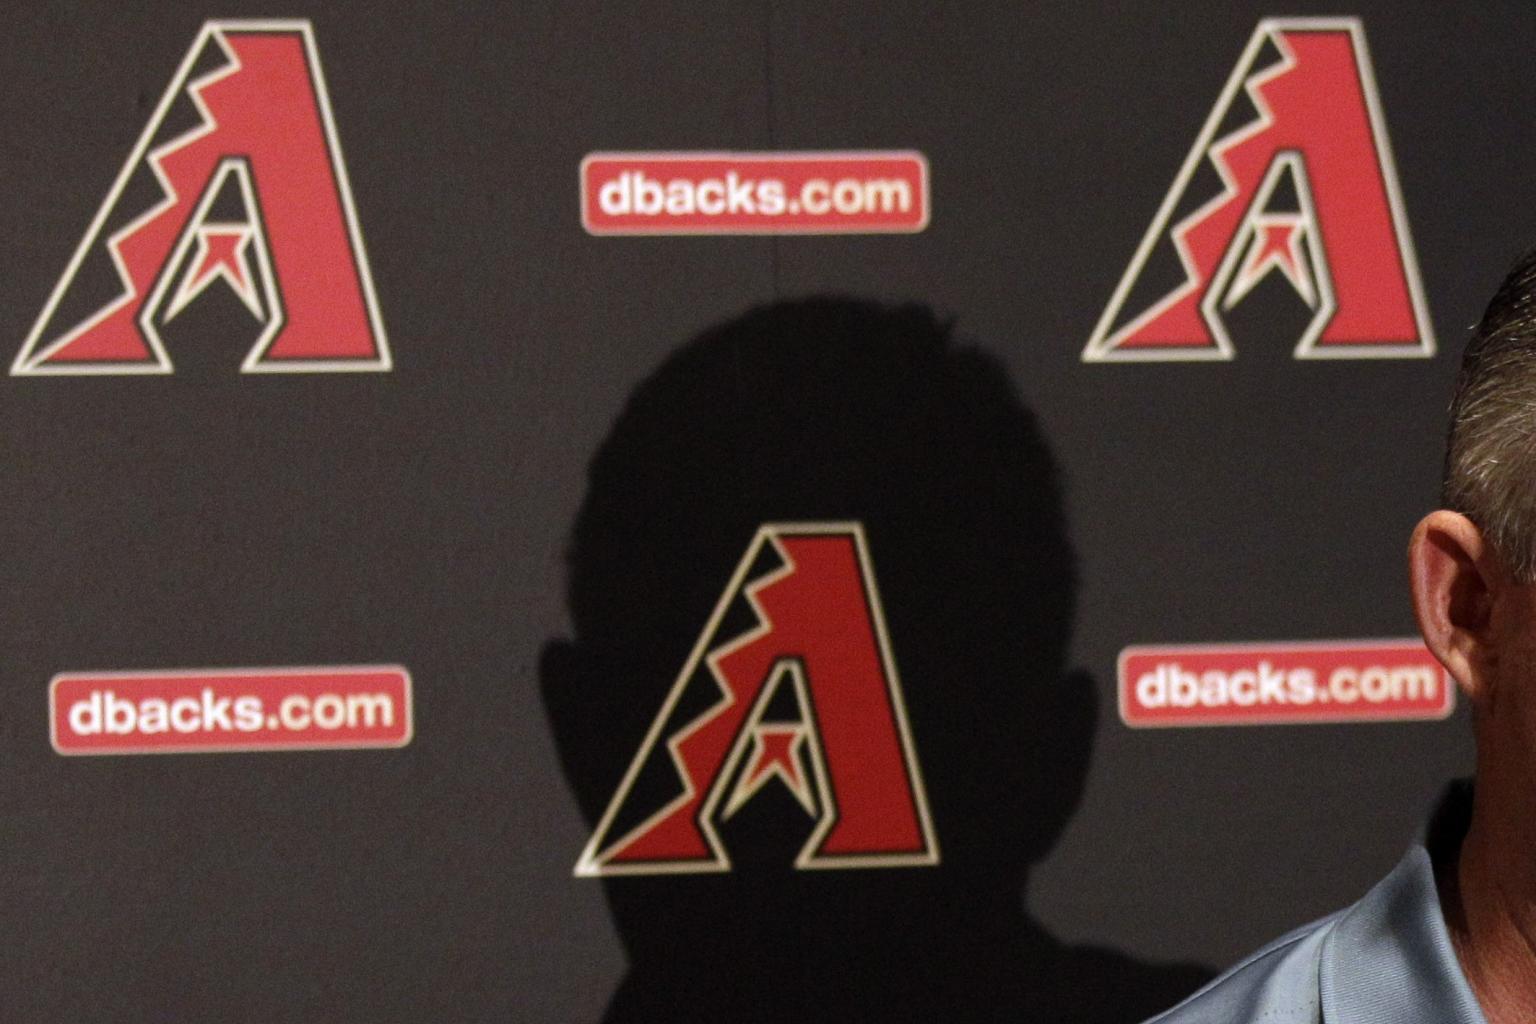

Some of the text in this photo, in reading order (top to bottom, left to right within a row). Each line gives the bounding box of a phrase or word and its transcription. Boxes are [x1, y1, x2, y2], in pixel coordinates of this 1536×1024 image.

[599, 170, 912, 216] dbacks.com
[1135, 661, 1437, 709] dbacks.com
[68, 688, 394, 736] dbacks.com
